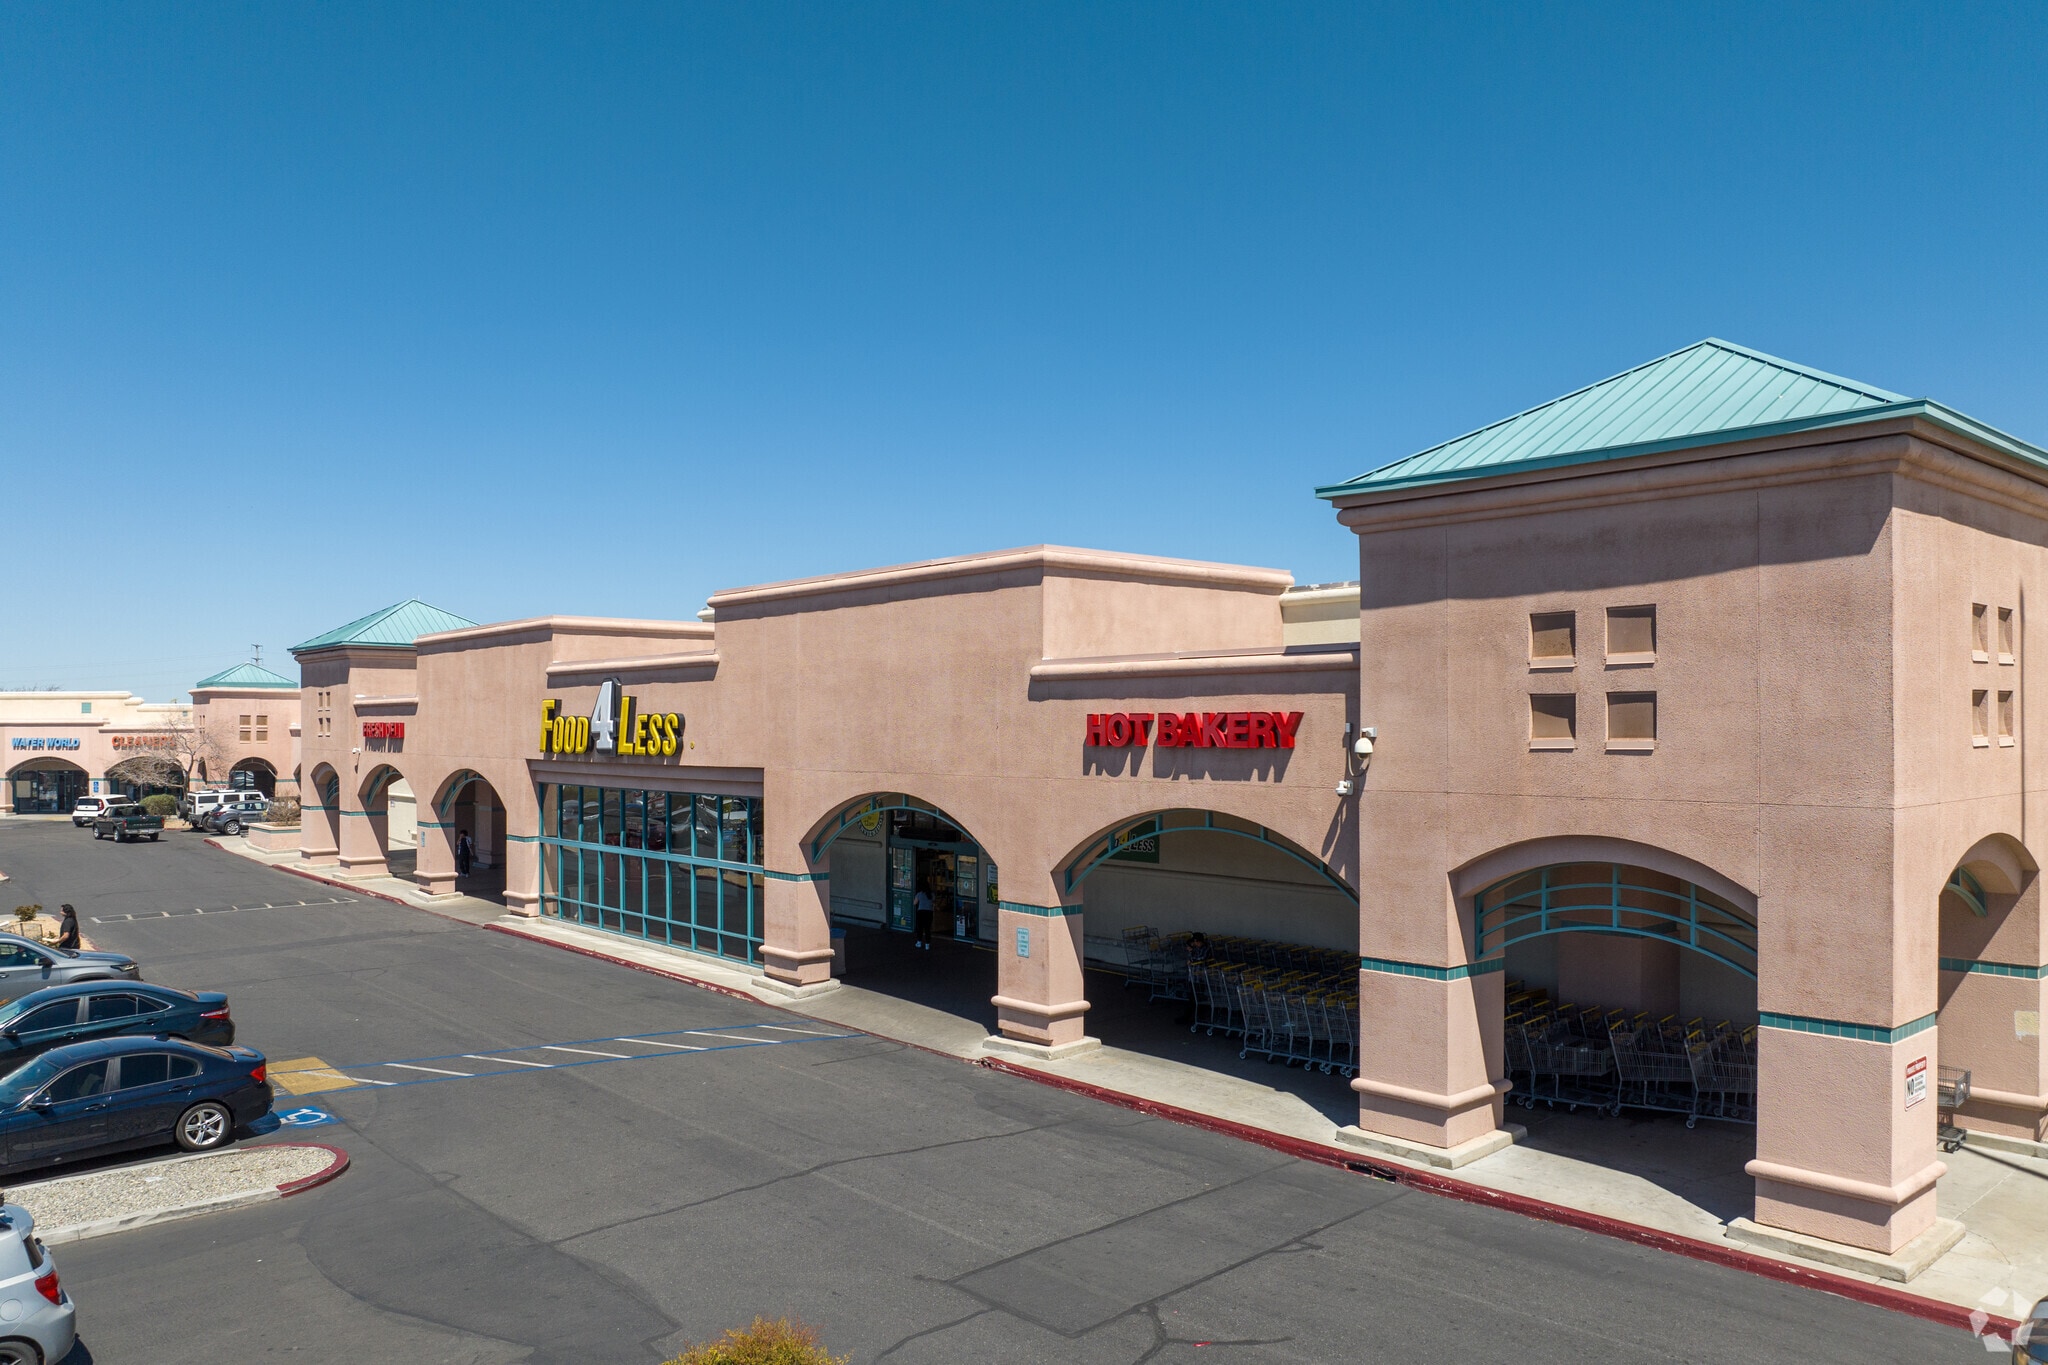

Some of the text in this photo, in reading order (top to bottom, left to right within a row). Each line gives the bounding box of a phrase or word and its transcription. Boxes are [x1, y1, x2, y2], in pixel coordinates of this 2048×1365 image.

[591, 677, 621, 755] 4
[111, 736, 177, 749] CLEANERS
[1087, 712, 1304, 749] HOT BAKERY
[12, 738, 80, 749] WATER WORLD
